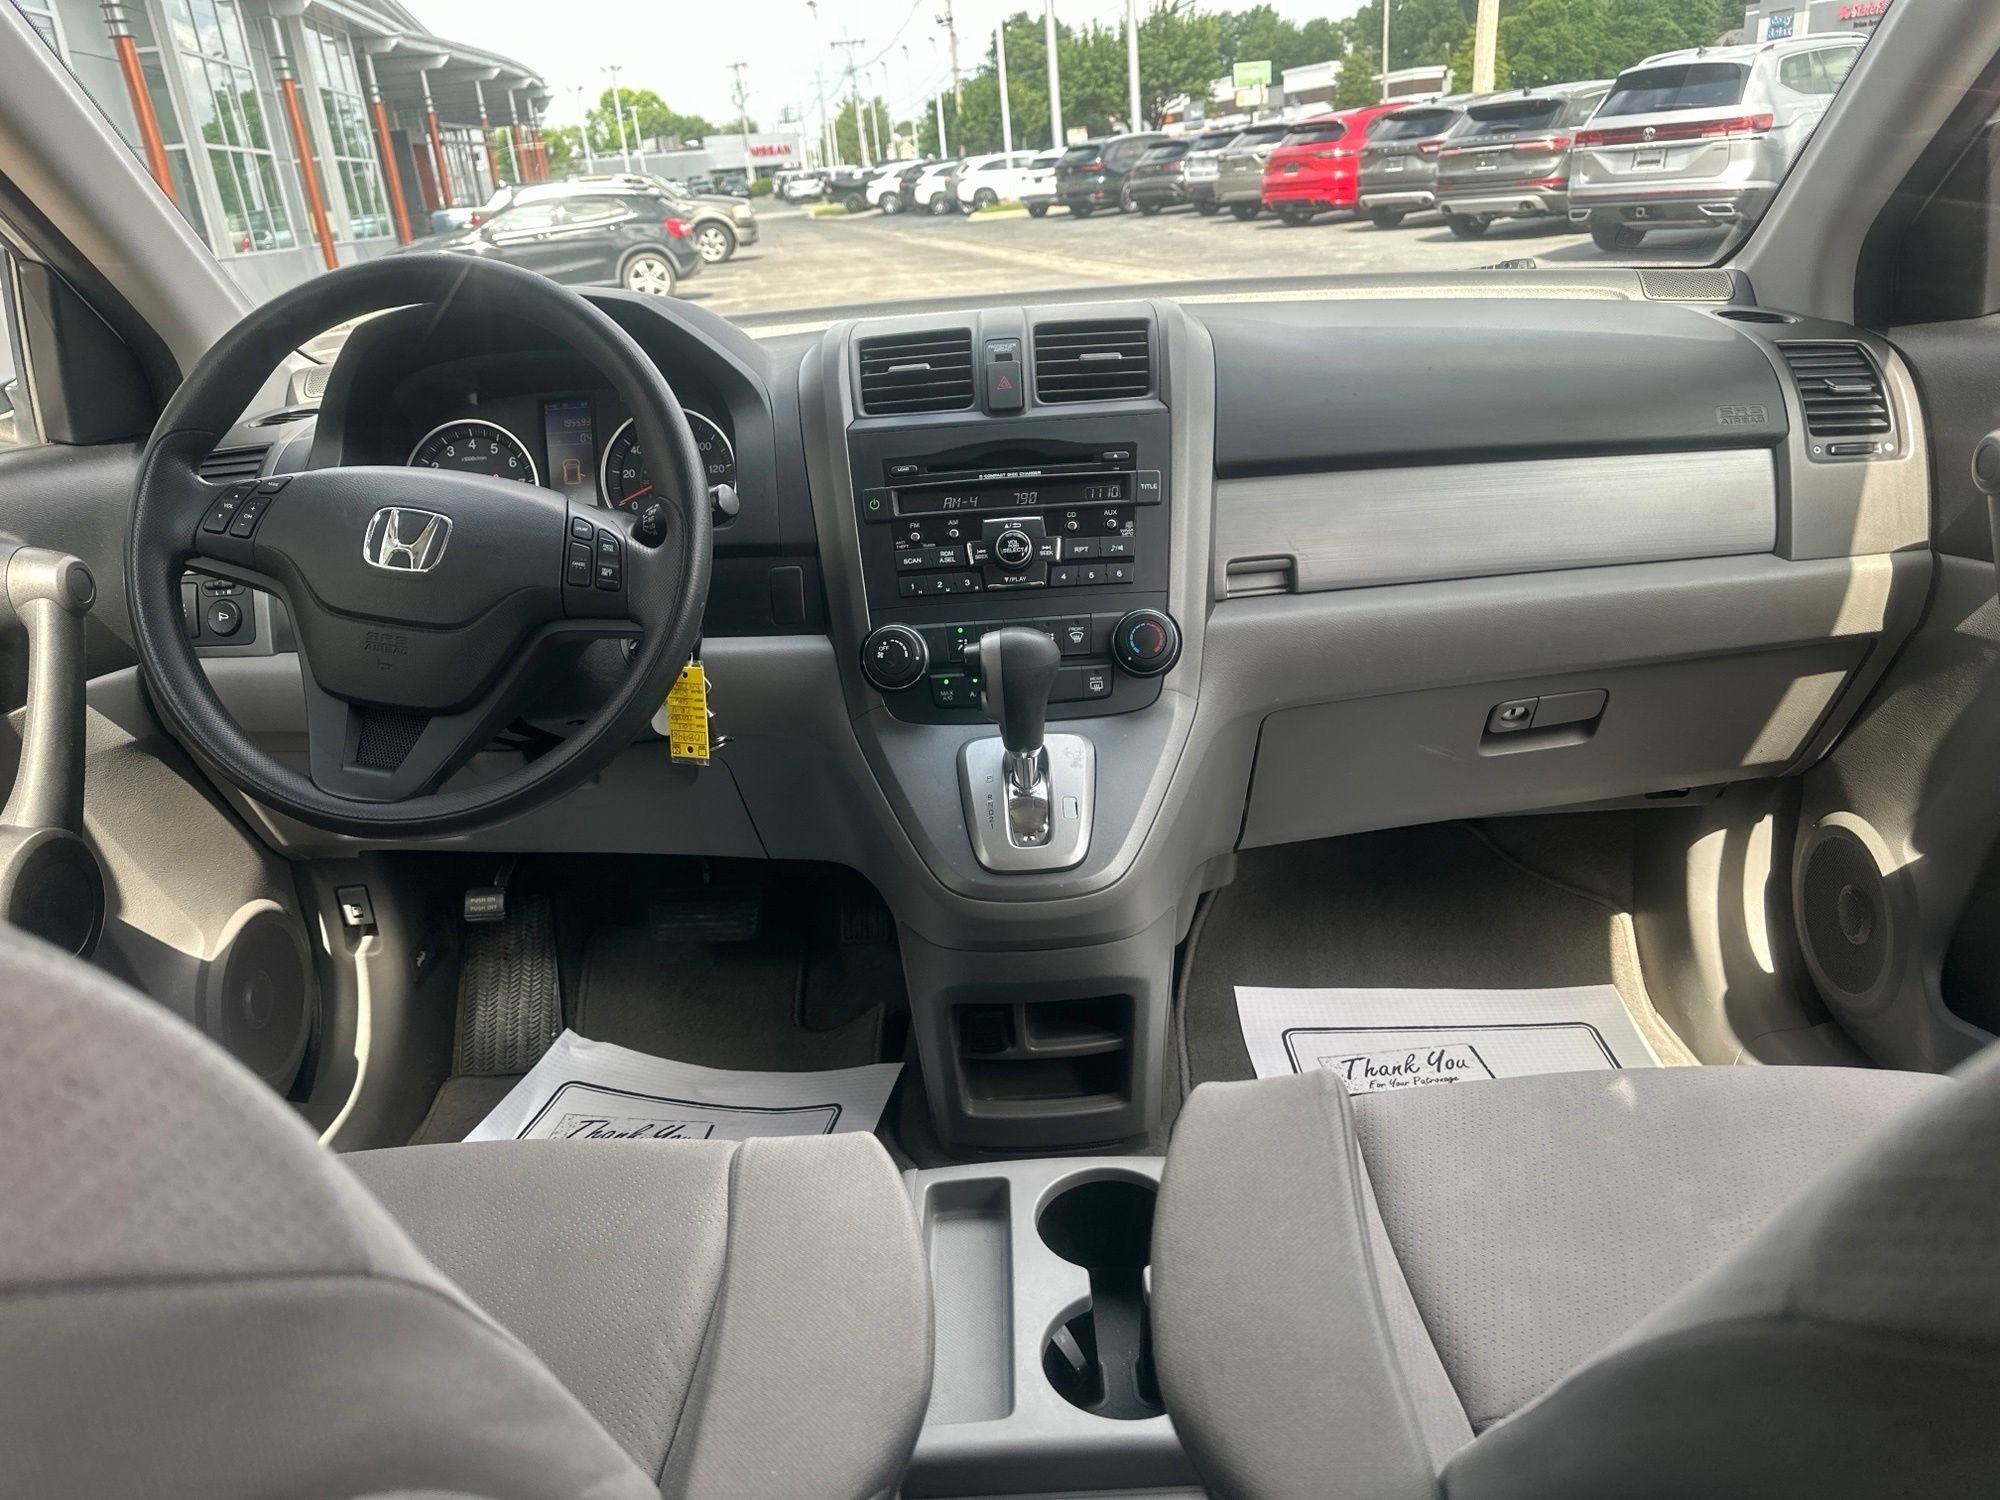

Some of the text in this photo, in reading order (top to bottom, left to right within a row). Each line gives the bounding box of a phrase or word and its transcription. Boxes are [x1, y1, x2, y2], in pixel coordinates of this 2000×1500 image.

[468, 438, 477, 450] 4
[490, 443, 499, 454] 5
[446, 445, 455, 457] 3
[508, 456, 517, 468] 6
[622, 470, 636, 479] 20
[708, 464, 725, 474] 120
[1013, 491, 1038, 504] 790
[631, 501, 638, 510] 0
[1060, 572, 1067, 580] 4
[1116, 569, 1123, 578] 6
[1340, 1048, 1470, 1081] Thank You
[1369, 1080, 1387, 1089] For
[1389, 1078, 1409, 1088] Your
